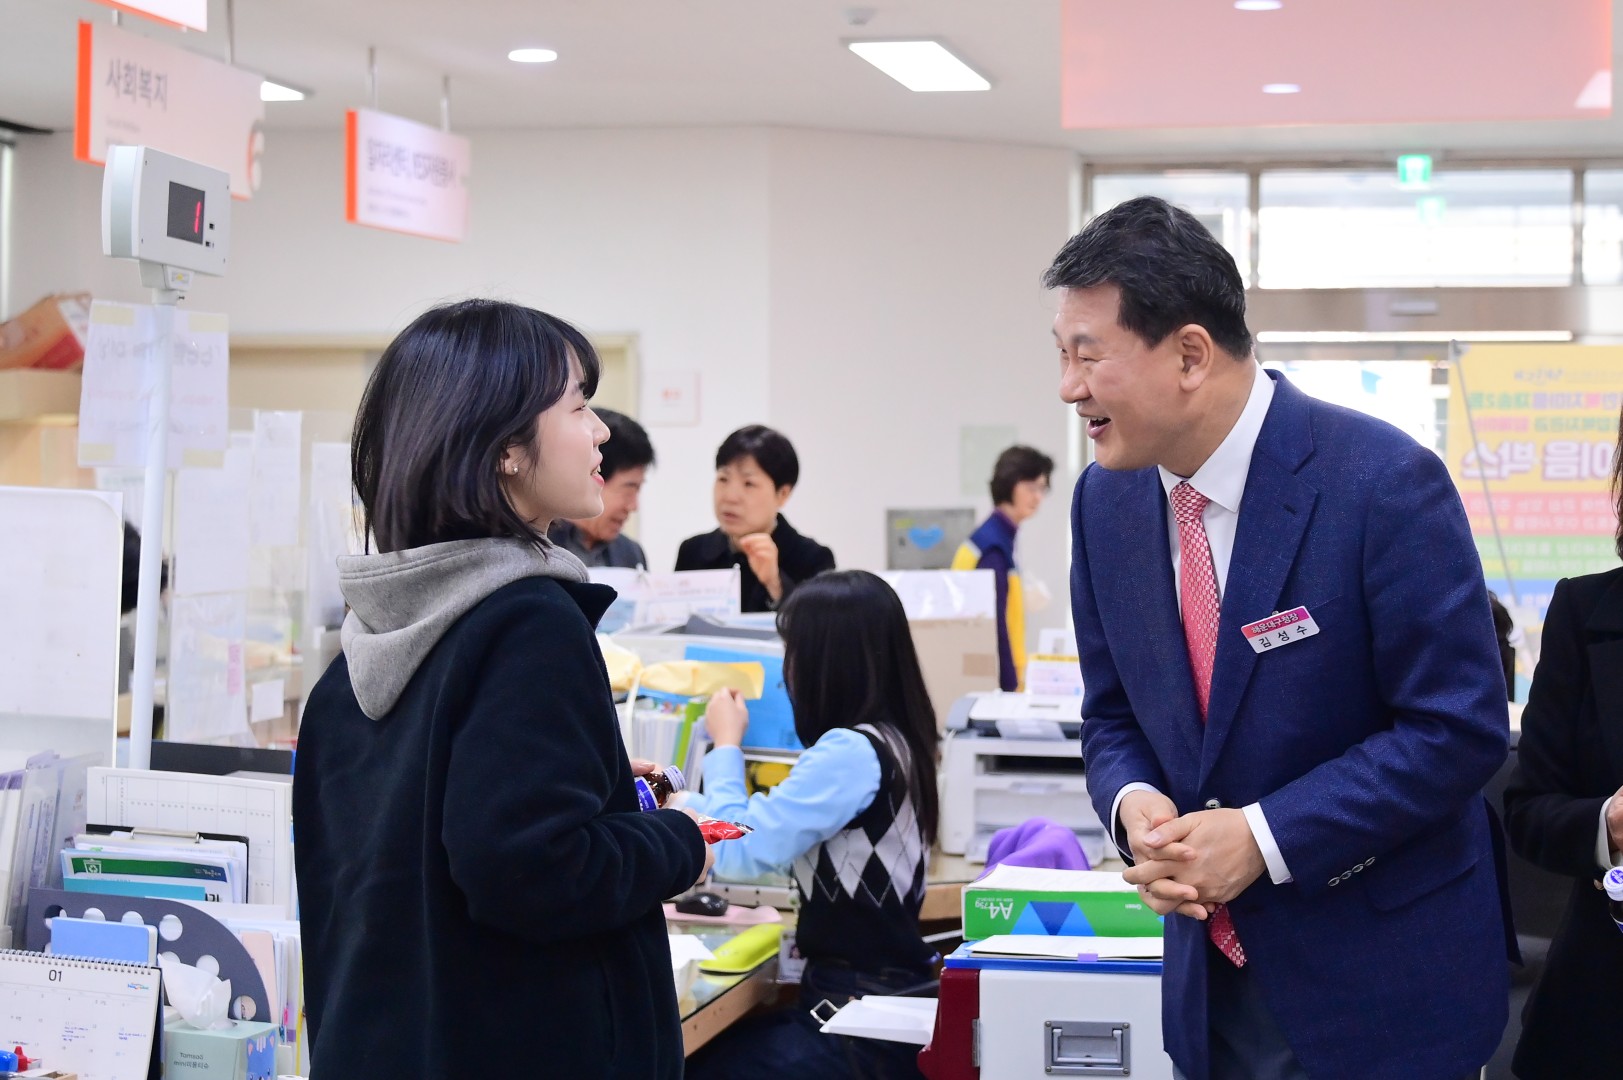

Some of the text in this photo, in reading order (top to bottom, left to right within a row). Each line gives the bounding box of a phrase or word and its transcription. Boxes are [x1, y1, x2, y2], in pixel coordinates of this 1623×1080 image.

[105, 57, 168, 111] 사회복지
[194, 201, 202, 234] 1
[1251, 613, 1300, 634] 해운대구청장
[989, 902, 1013, 920] A4
[48, 969, 63, 982] 01
